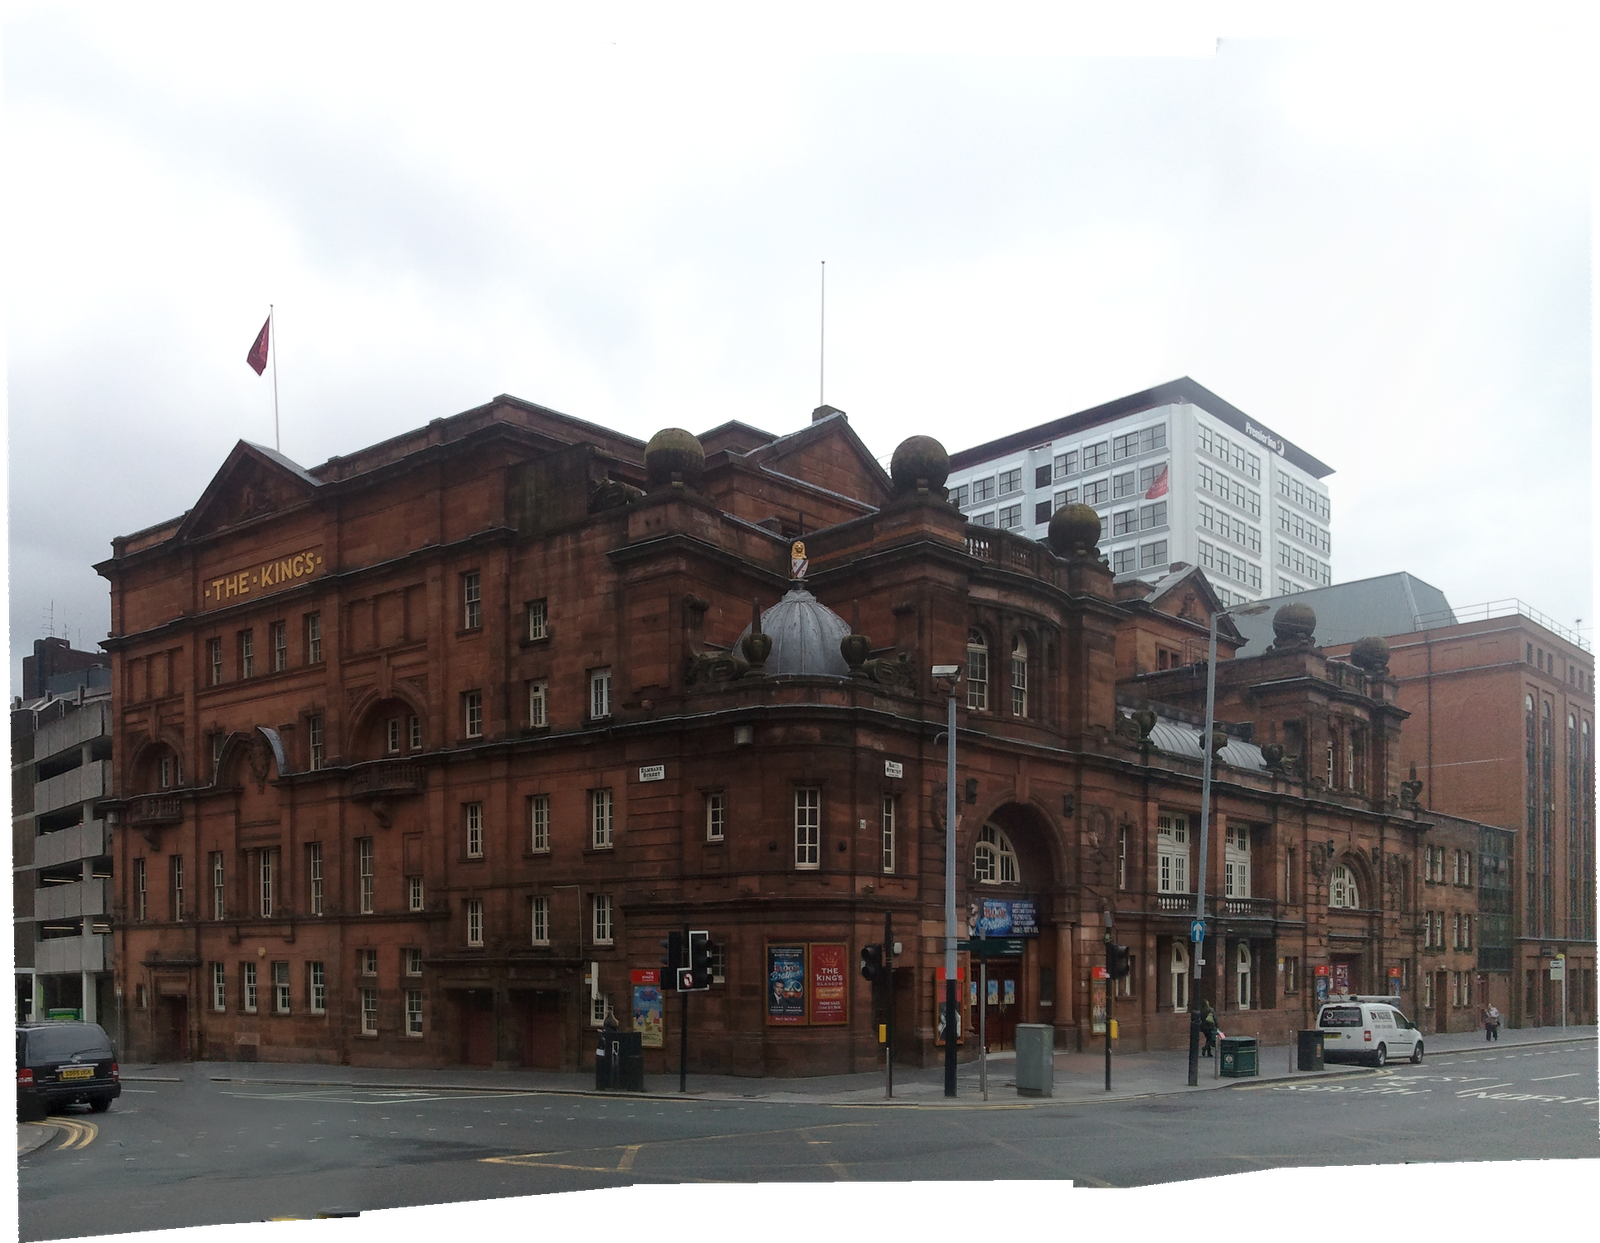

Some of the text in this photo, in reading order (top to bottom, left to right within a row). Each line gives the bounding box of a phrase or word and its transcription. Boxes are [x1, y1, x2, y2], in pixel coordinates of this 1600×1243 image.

[1246, 421, 1277, 450] Premier Inn
[212, 552, 315, 600] THE KING'S
